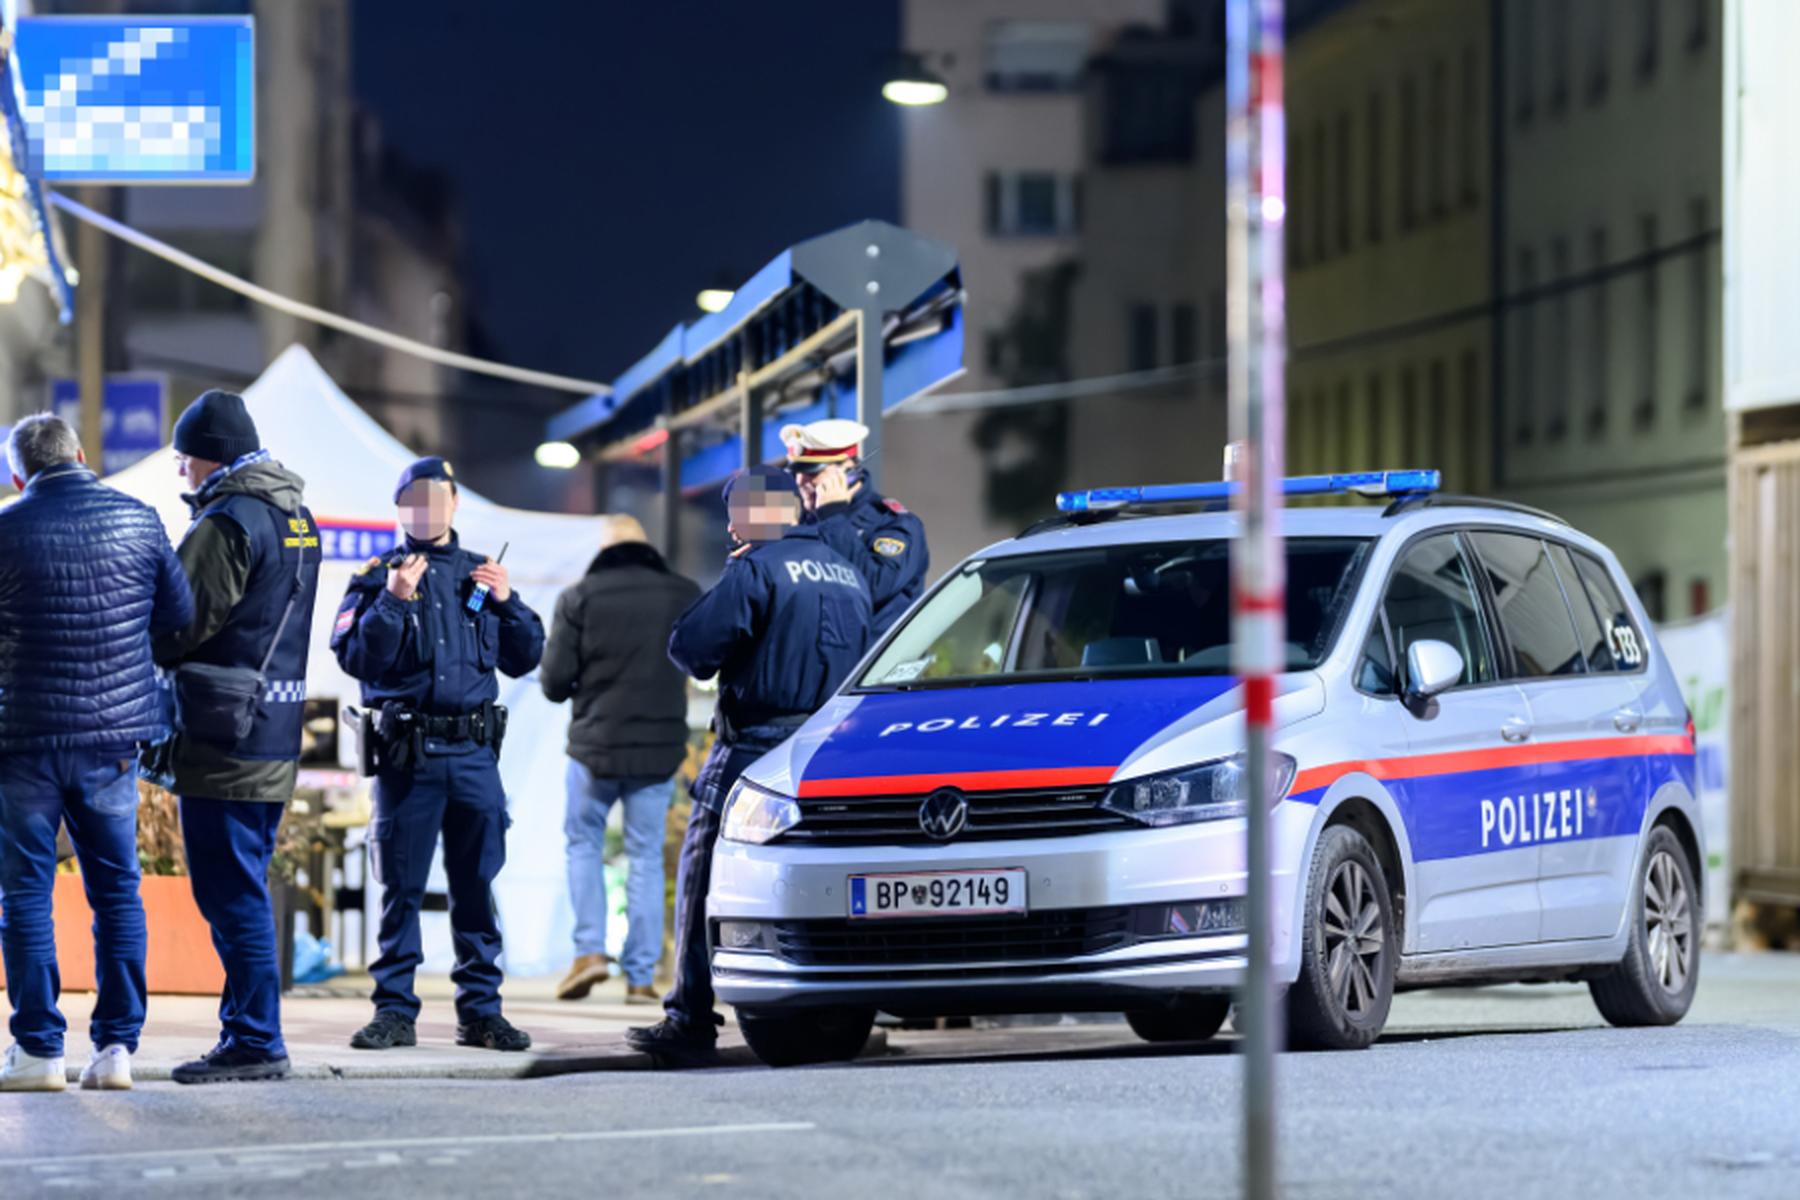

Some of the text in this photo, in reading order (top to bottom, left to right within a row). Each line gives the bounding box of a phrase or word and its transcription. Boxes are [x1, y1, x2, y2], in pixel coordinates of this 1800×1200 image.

[784, 559, 861, 590] POLIZEI
[1613, 625, 1641, 664] 133
[878, 712, 1110, 738] POLIZEI
[1480, 787, 1583, 848] POLIZEI
[876, 876, 1010, 910] BP 92149
